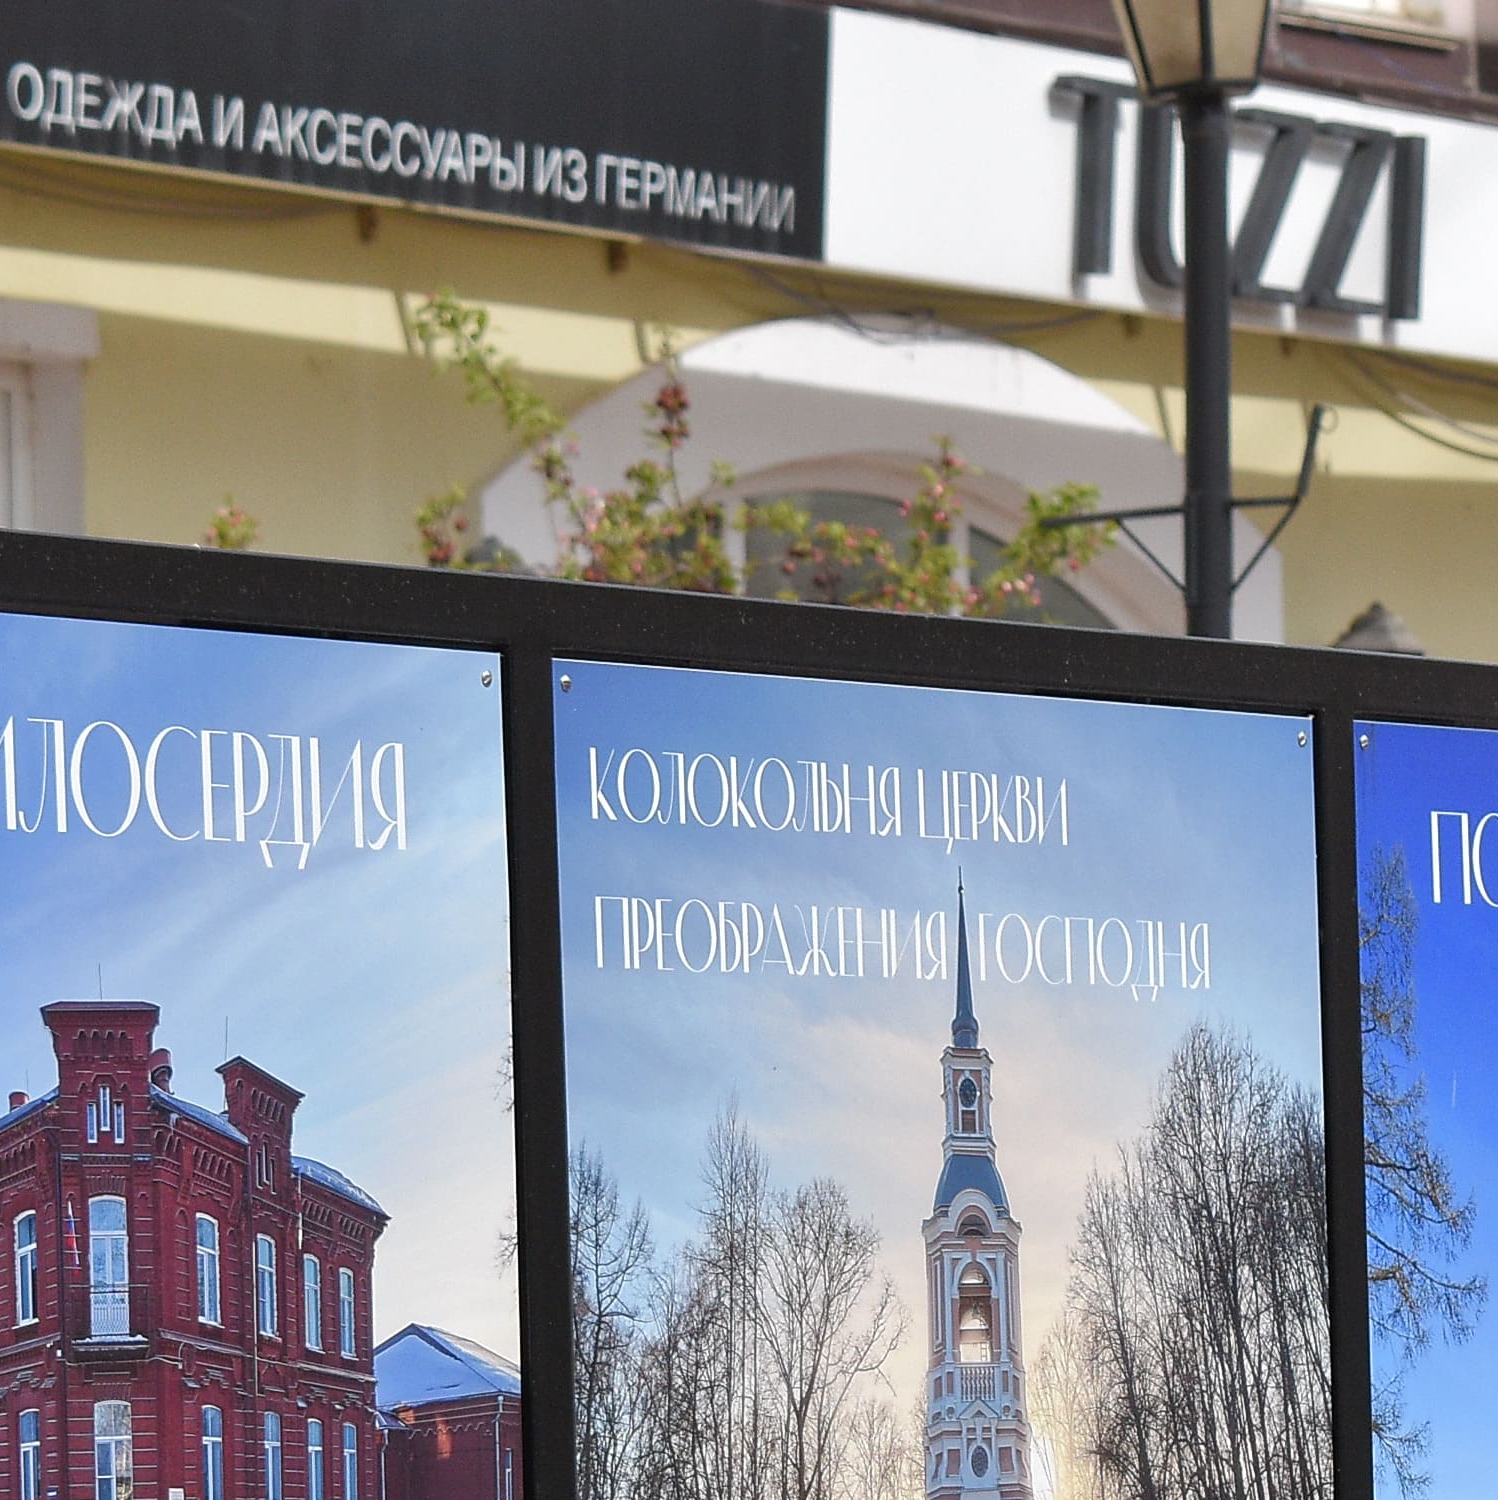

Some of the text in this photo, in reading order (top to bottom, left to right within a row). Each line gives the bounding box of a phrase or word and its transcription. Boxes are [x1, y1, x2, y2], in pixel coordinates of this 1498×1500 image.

[6, 61, 797, 236] ОДЕЖДА И АКСЕССУАРЫ ИЗ ГЕРМАНИИ
[1048, 73, 1427, 324] TUZZI
[588, 746, 1071, 856] КОЛОКОЛЬНЯ ЦЕРКВИ
[594, 895, 1212, 1003] ПРЕОБРАЖЕНИЯ ГОСПОДНЯ
